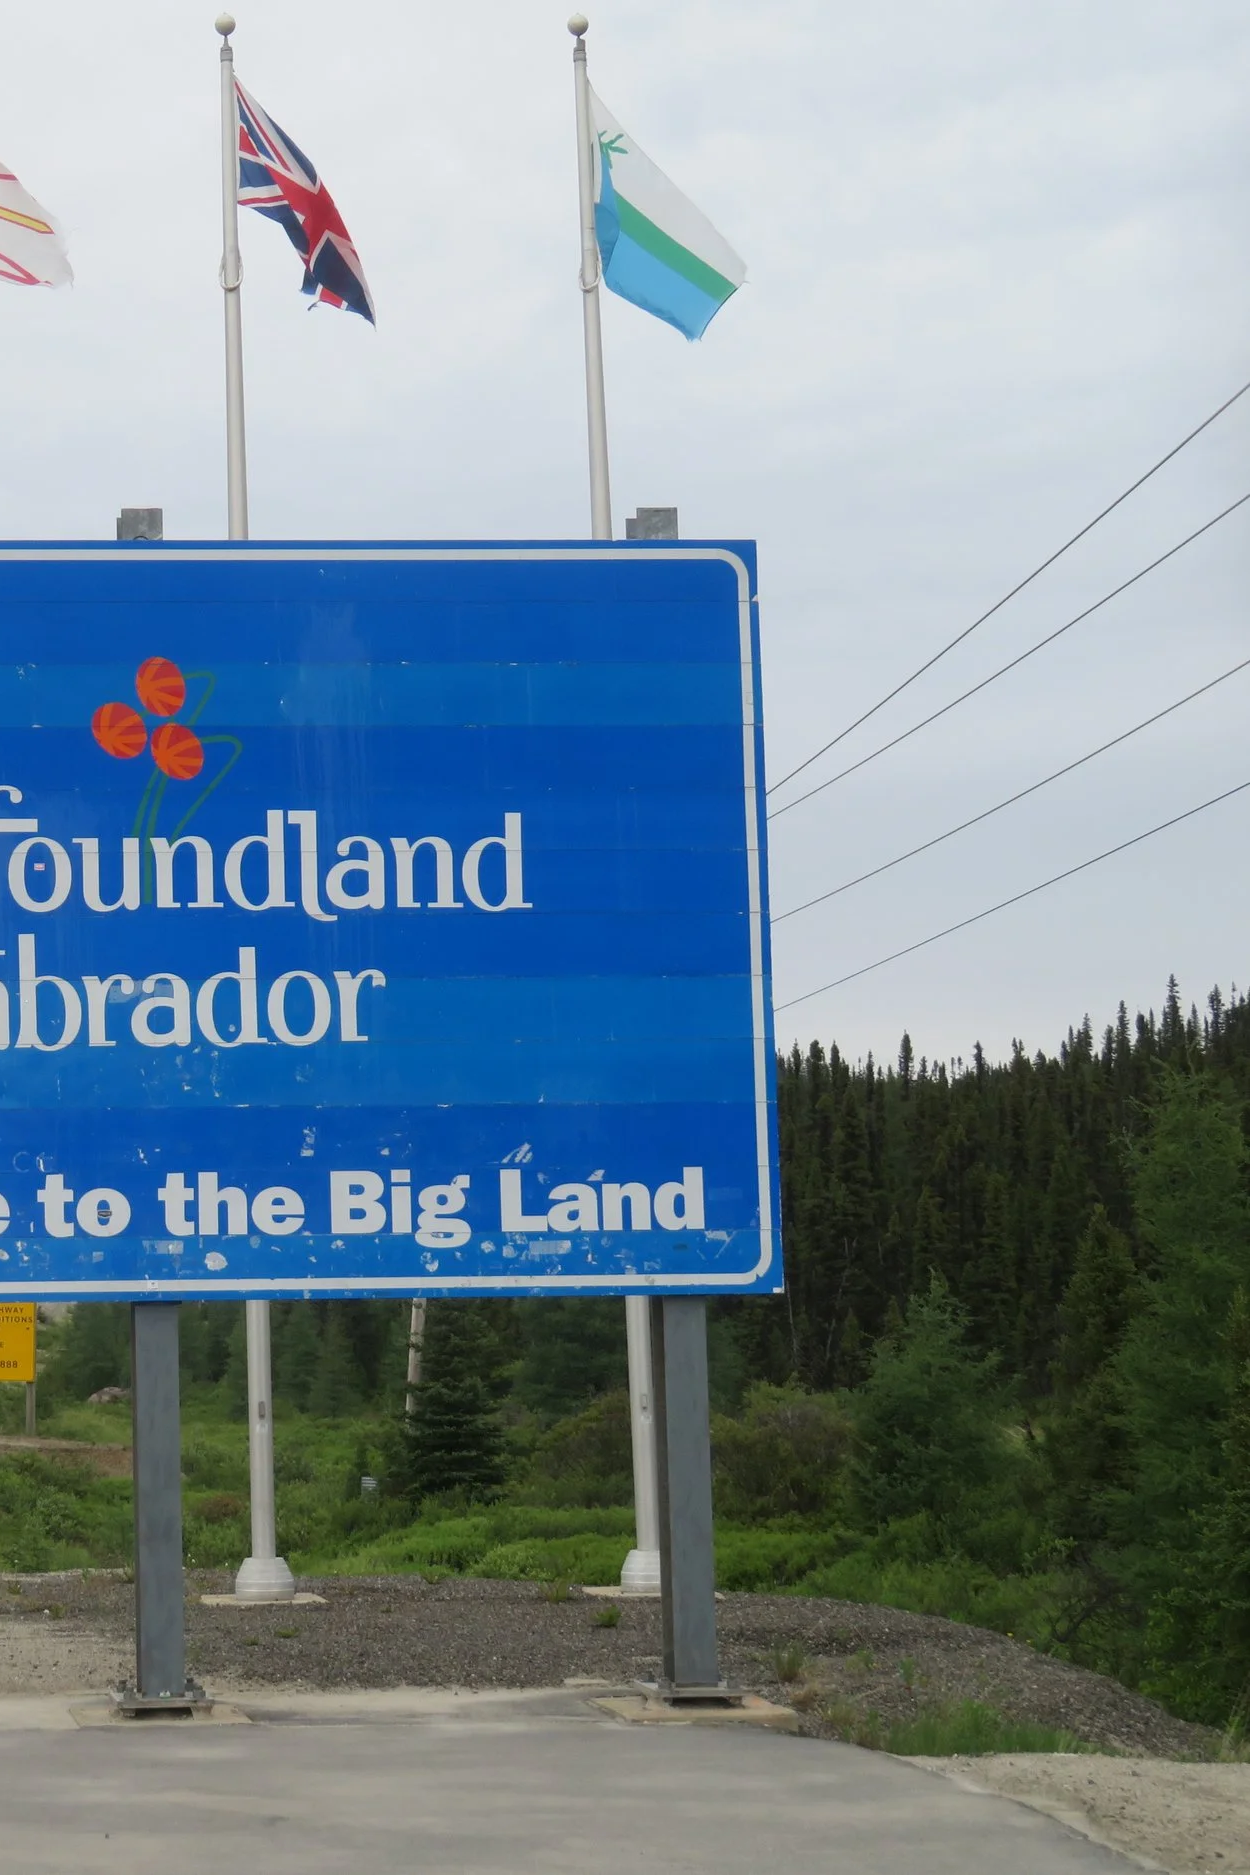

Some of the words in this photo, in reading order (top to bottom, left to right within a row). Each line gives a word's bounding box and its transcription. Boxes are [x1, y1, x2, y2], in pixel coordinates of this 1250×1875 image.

[36, 1174, 131, 1238] to
[157, 1171, 305, 1236] the
[329, 1168, 472, 1249] Big
[499, 1166, 706, 1232] Land
